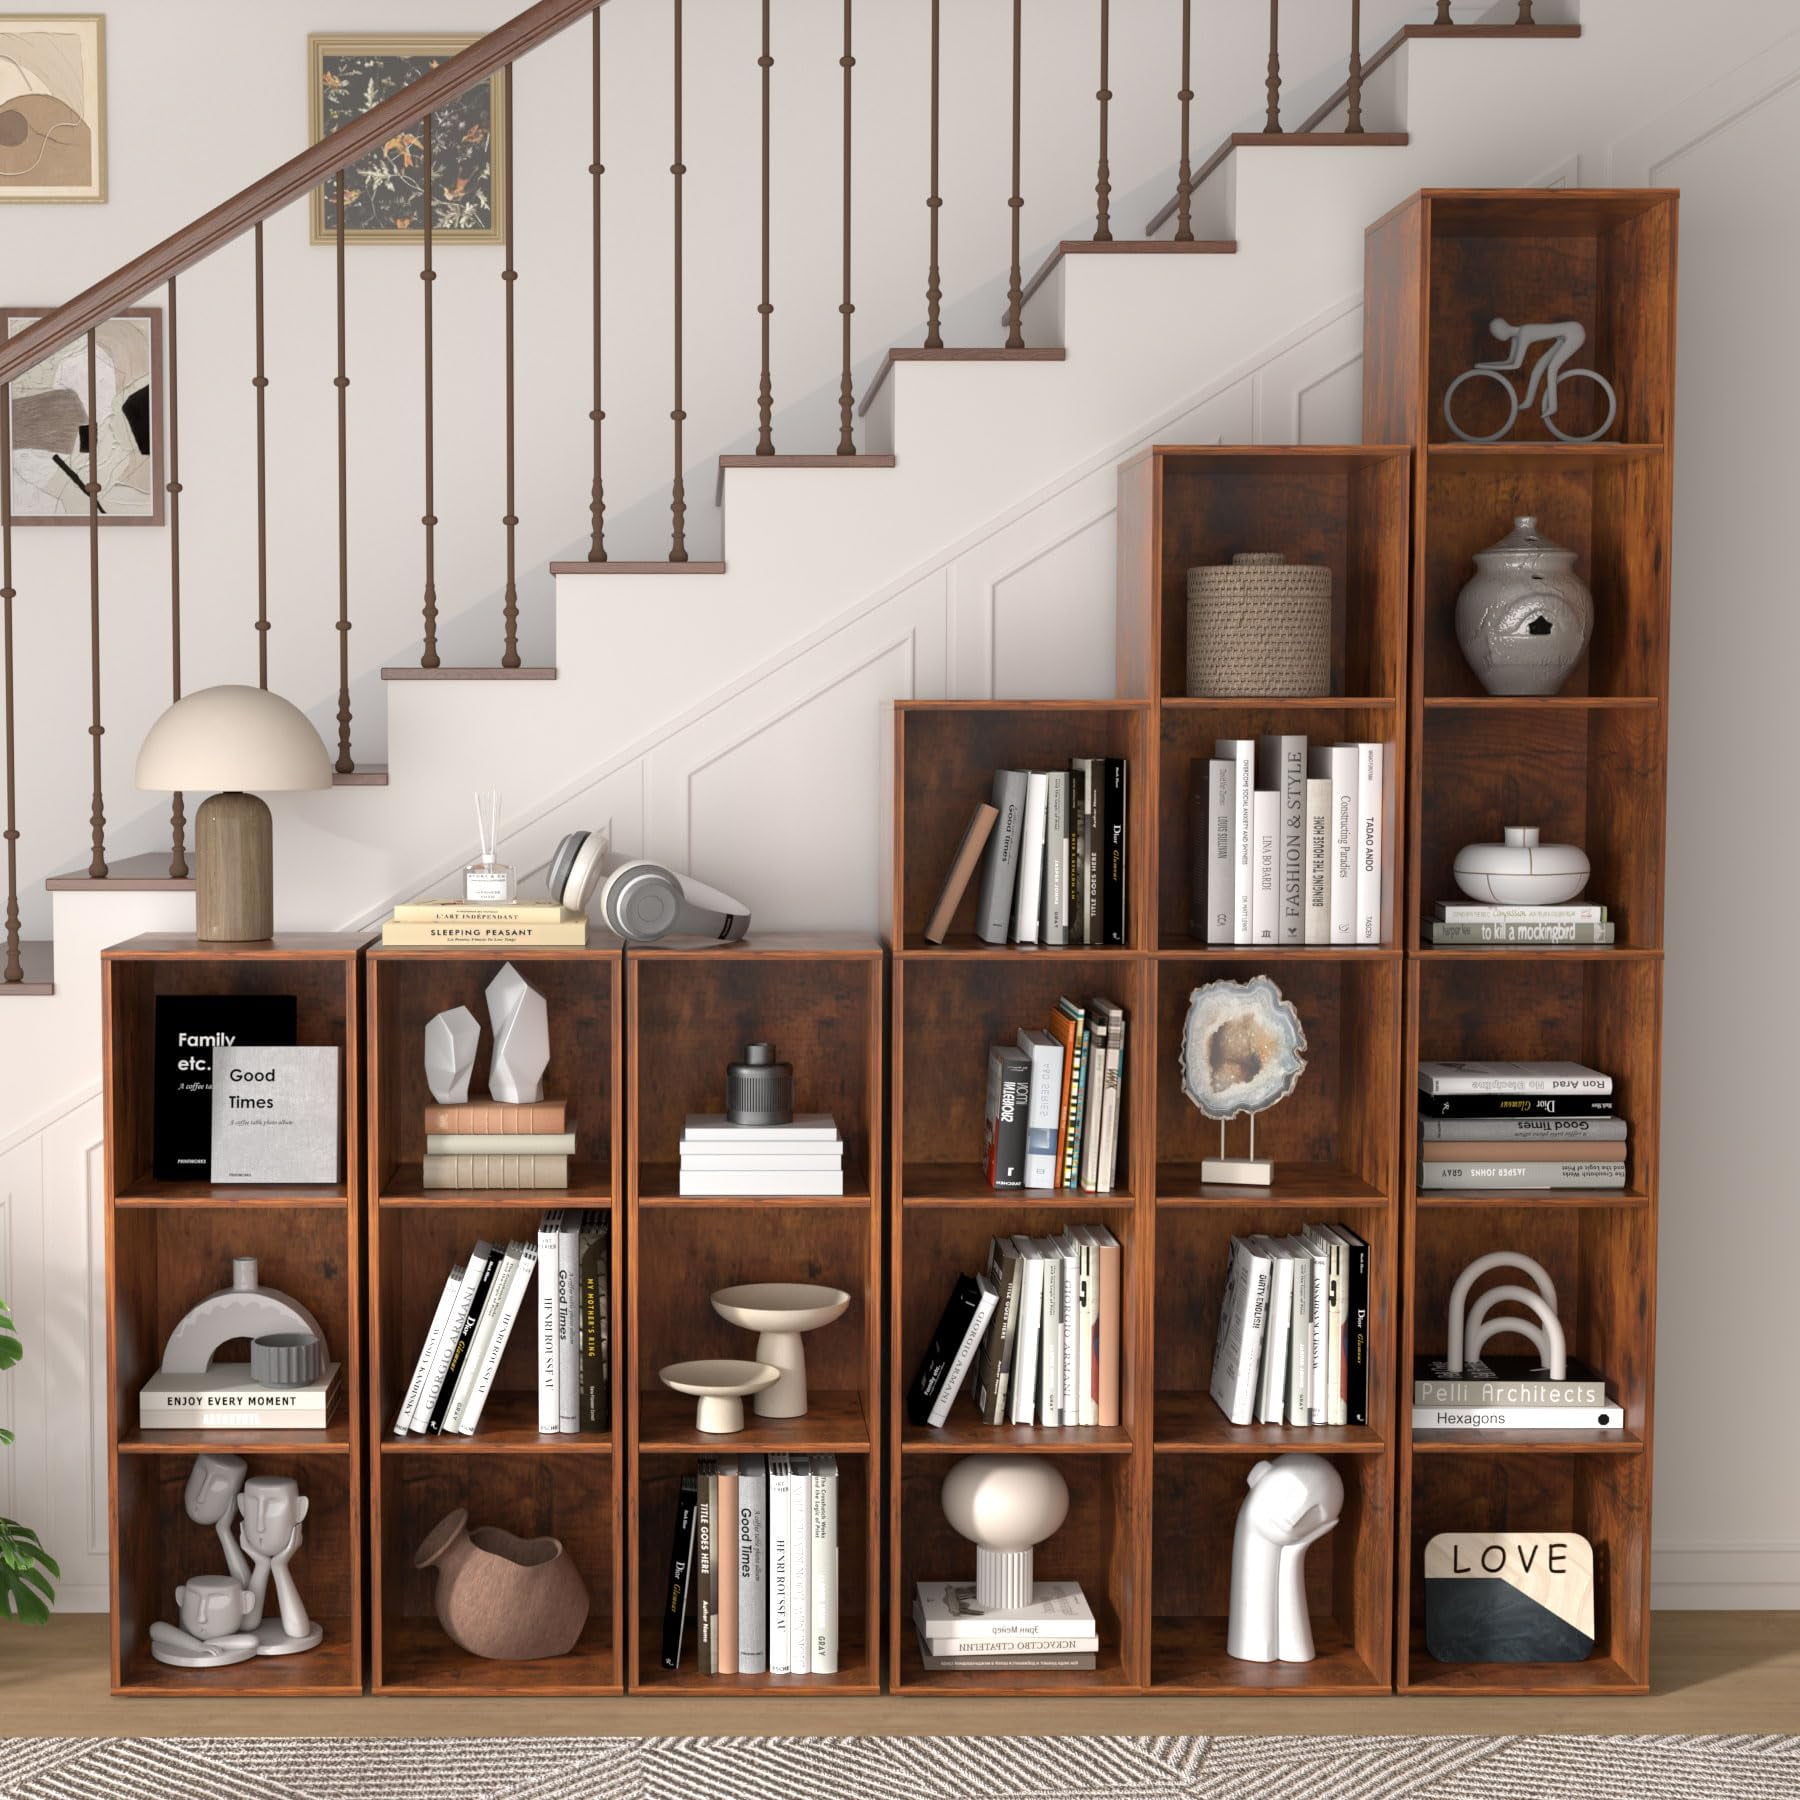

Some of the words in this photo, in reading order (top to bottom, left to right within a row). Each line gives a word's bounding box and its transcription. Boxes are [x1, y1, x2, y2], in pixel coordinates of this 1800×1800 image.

[1288, 752, 1302, 809] STYLE
[1006, 804, 1015, 832] Good
[1218, 816, 1228, 832] LOUIS
[1288, 816, 1301, 829] &
[1313, 816, 1324, 835] HOME
[1338, 796, 1351, 844] Constructing
[1113, 824, 1122, 844] Dior
[1365, 817, 1374, 846] TADAO
[1002, 835, 1011, 863] Times
[1217, 833, 1228, 859] SULLIVAN
[1262, 836, 1272, 854] LINA
[1312, 837, 1324, 858] HOUSE
[1262, 856, 1272, 866] BO
[1312, 860, 1324, 874] THE
[1338, 847, 1351, 878] Paradies
[1365, 848, 1374, 872] ANDO
[1262, 867, 1272, 890] BARDI
[1286, 836, 1300, 917] FASHION
[1312, 875, 1324, 907] BRINGING
[1217, 913, 1227, 926] CCA
[1481, 925, 1491, 940] to
[1494, 923, 1506, 940] kill
[1508, 926, 1515, 940] a
[1517, 923, 1576, 943] mockingbird
[178, 1032, 236, 1047] Family
[177, 1056, 212, 1071] etc.
[230, 1069, 275, 1082] Good
[229, 1096, 274, 1109] Times
[1500, 1100, 1531, 1111] Glamour
[1536, 1100, 1556, 1113] Dior
[1518, 1122, 1551, 1130] Times
[1555, 1122, 1589, 1130] Good
[1442, 1169, 1462, 1177] GRAY
[1470, 1168, 1496, 1177] JOHNS
[1499, 1168, 1526, 1177] JASPER
[559, 1270, 568, 1304] Good
[587, 1278, 595, 1289] MY
[559, 1307, 568, 1340] Times
[587, 1294, 595, 1334] MOTHER'S
[1357, 1309, 1366, 1328] Dior
[462, 1316, 476, 1337] Dior
[961, 1311, 985, 1360] GIORGIO
[425, 1348, 452, 1411] GIORGIO
[450, 1287, 475, 1345] ARMANI
[588, 1337, 596, 1357] RING
[924, 1375, 936, 1396] Family
[940, 1359, 963, 1404] ARMANI
[167, 1396, 203, 1406] ENJOY
[208, 1396, 243, 1406] EVERY
[248, 1396, 297, 1406] MOMENT
[1422, 1384, 1469, 1401] Pelli
[1482, 1384, 1595, 1402] Architects
[1437, 1412, 1505, 1427] Hexagons
[700, 1504, 709, 1524] TITLE
[741, 1508, 752, 1542] Good
[700, 1526, 709, 1552] GOES
[701, 1554, 709, 1574] HERE
[741, 1545, 753, 1578] Times
[1454, 1544, 1567, 1574] LOVE
[675, 1561, 686, 1580] Dior
[818, 1636, 826, 1656] GRAY
